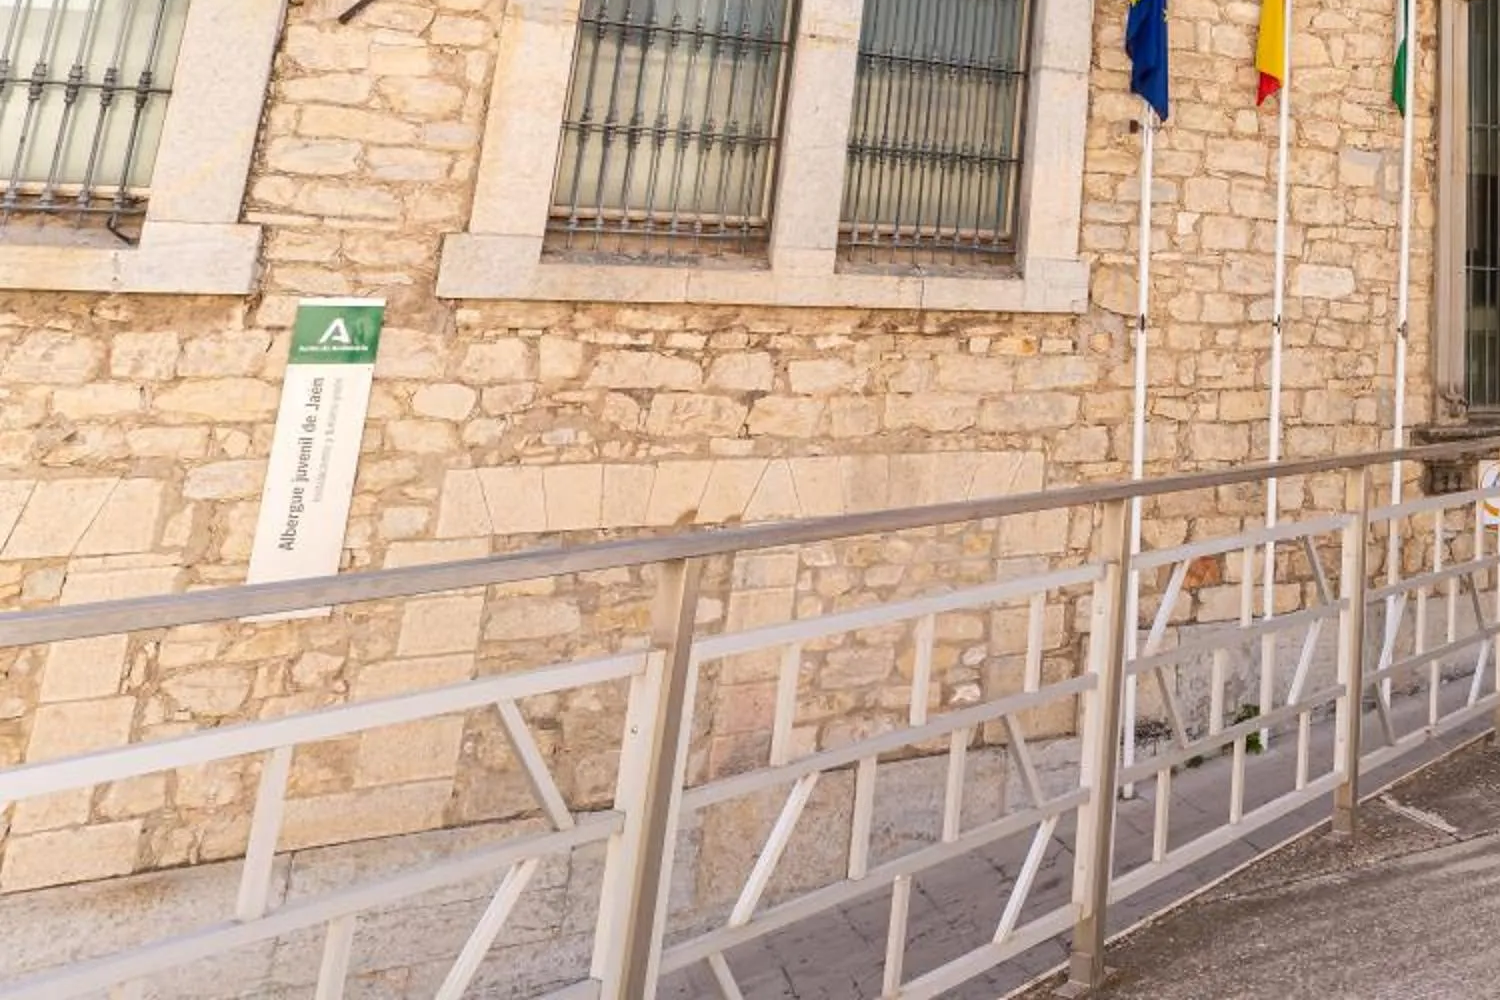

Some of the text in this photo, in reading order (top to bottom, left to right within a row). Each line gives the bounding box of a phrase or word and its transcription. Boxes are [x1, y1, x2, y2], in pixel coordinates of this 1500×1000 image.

[302, 415, 317, 433] de
[291, 437, 314, 482] juvenil
[278, 487, 305, 551] Albergue
